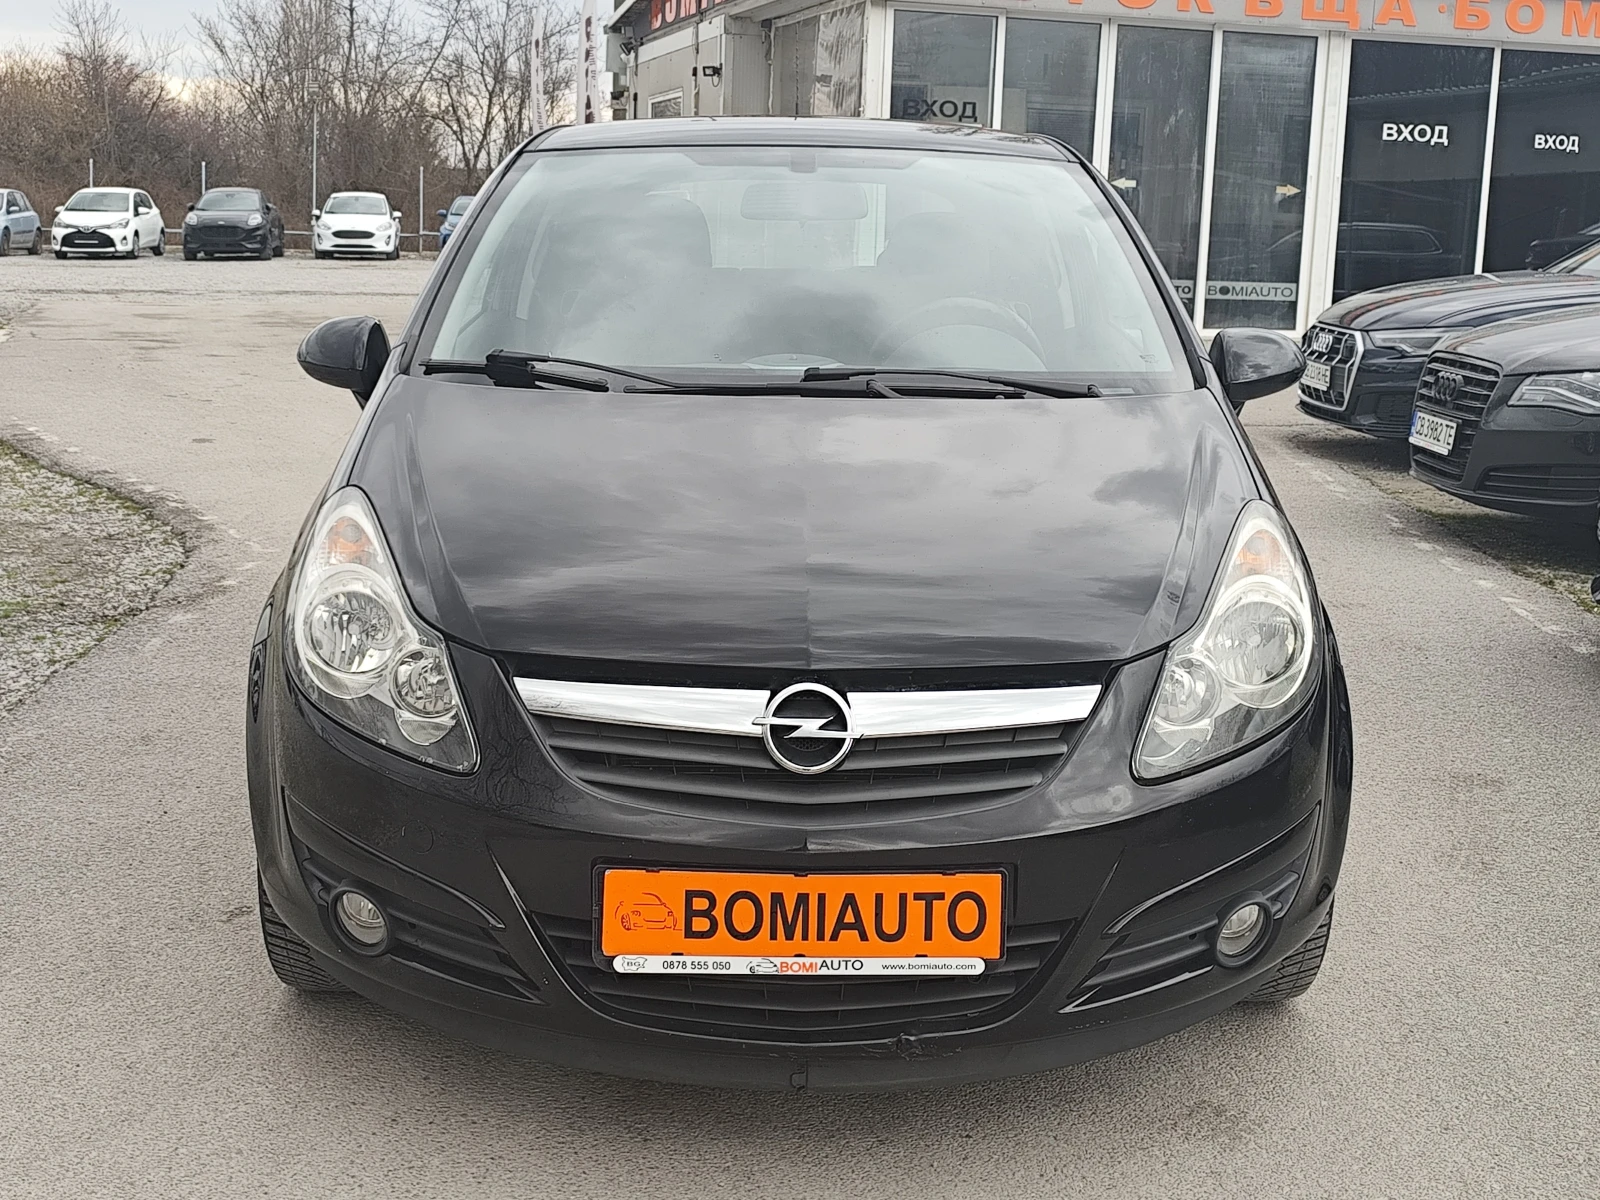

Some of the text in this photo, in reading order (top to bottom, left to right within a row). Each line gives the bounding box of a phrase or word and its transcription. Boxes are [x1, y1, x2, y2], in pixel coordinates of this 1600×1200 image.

[903, 99, 978, 122] ВХОД
[1382, 123, 1449, 146] ВХОД
[1534, 134, 1580, 153] ВХОД
[683, 889, 988, 942] BOMIAUTO
[662, 960, 731, 970] 0878 555 050
